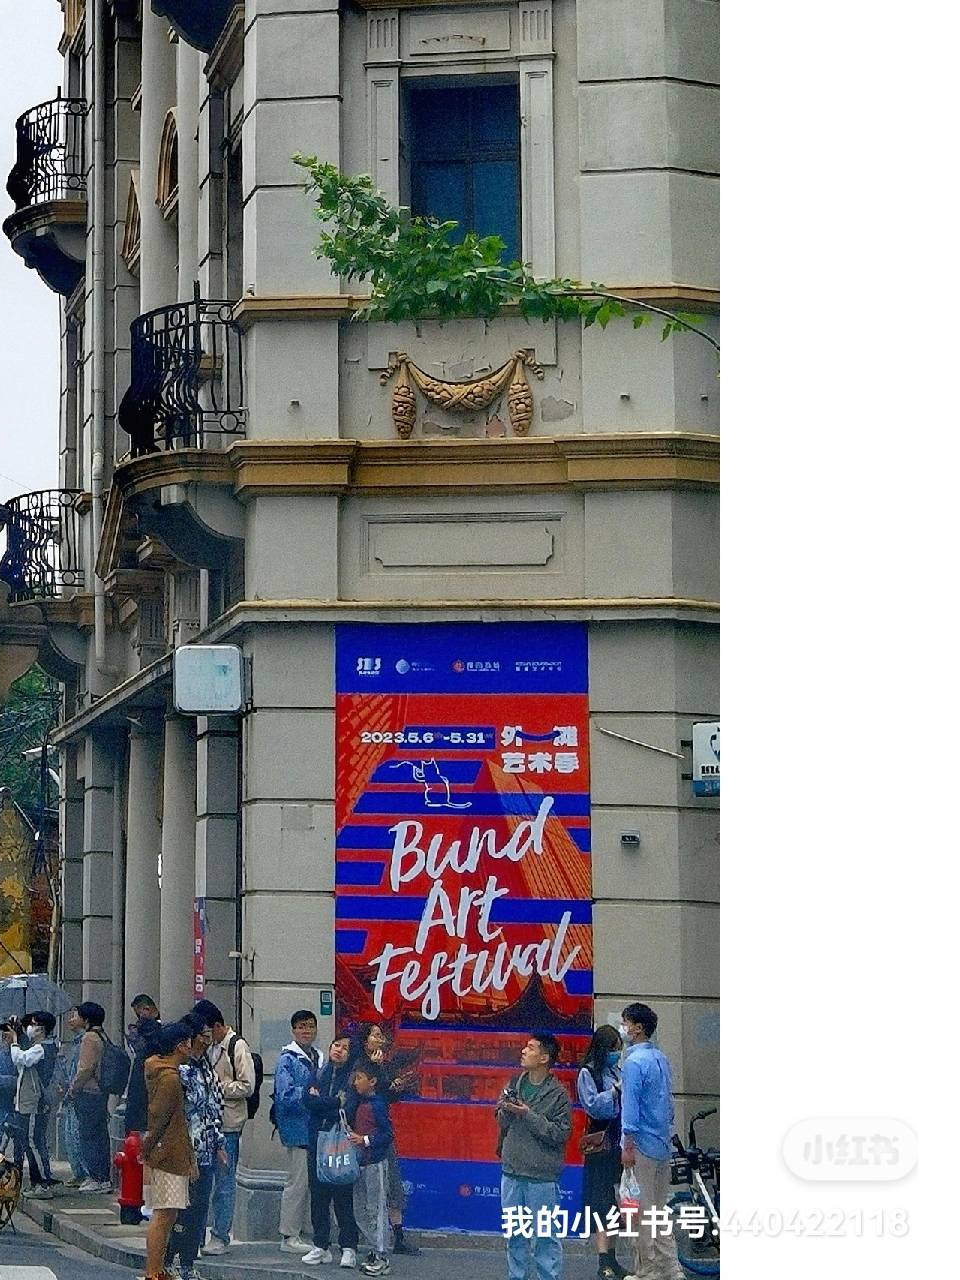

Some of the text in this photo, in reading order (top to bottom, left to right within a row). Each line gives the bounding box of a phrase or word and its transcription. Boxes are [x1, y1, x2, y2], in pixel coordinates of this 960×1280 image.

[360, 731, 434, 744] 2023.5.6
[500, 725, 579, 747] 外滩
[501, 751, 580, 774] 艺术季
[388, 795, 555, 893] Bund
[414, 875, 510, 955] Art
[367, 910, 582, 1021] Festival
